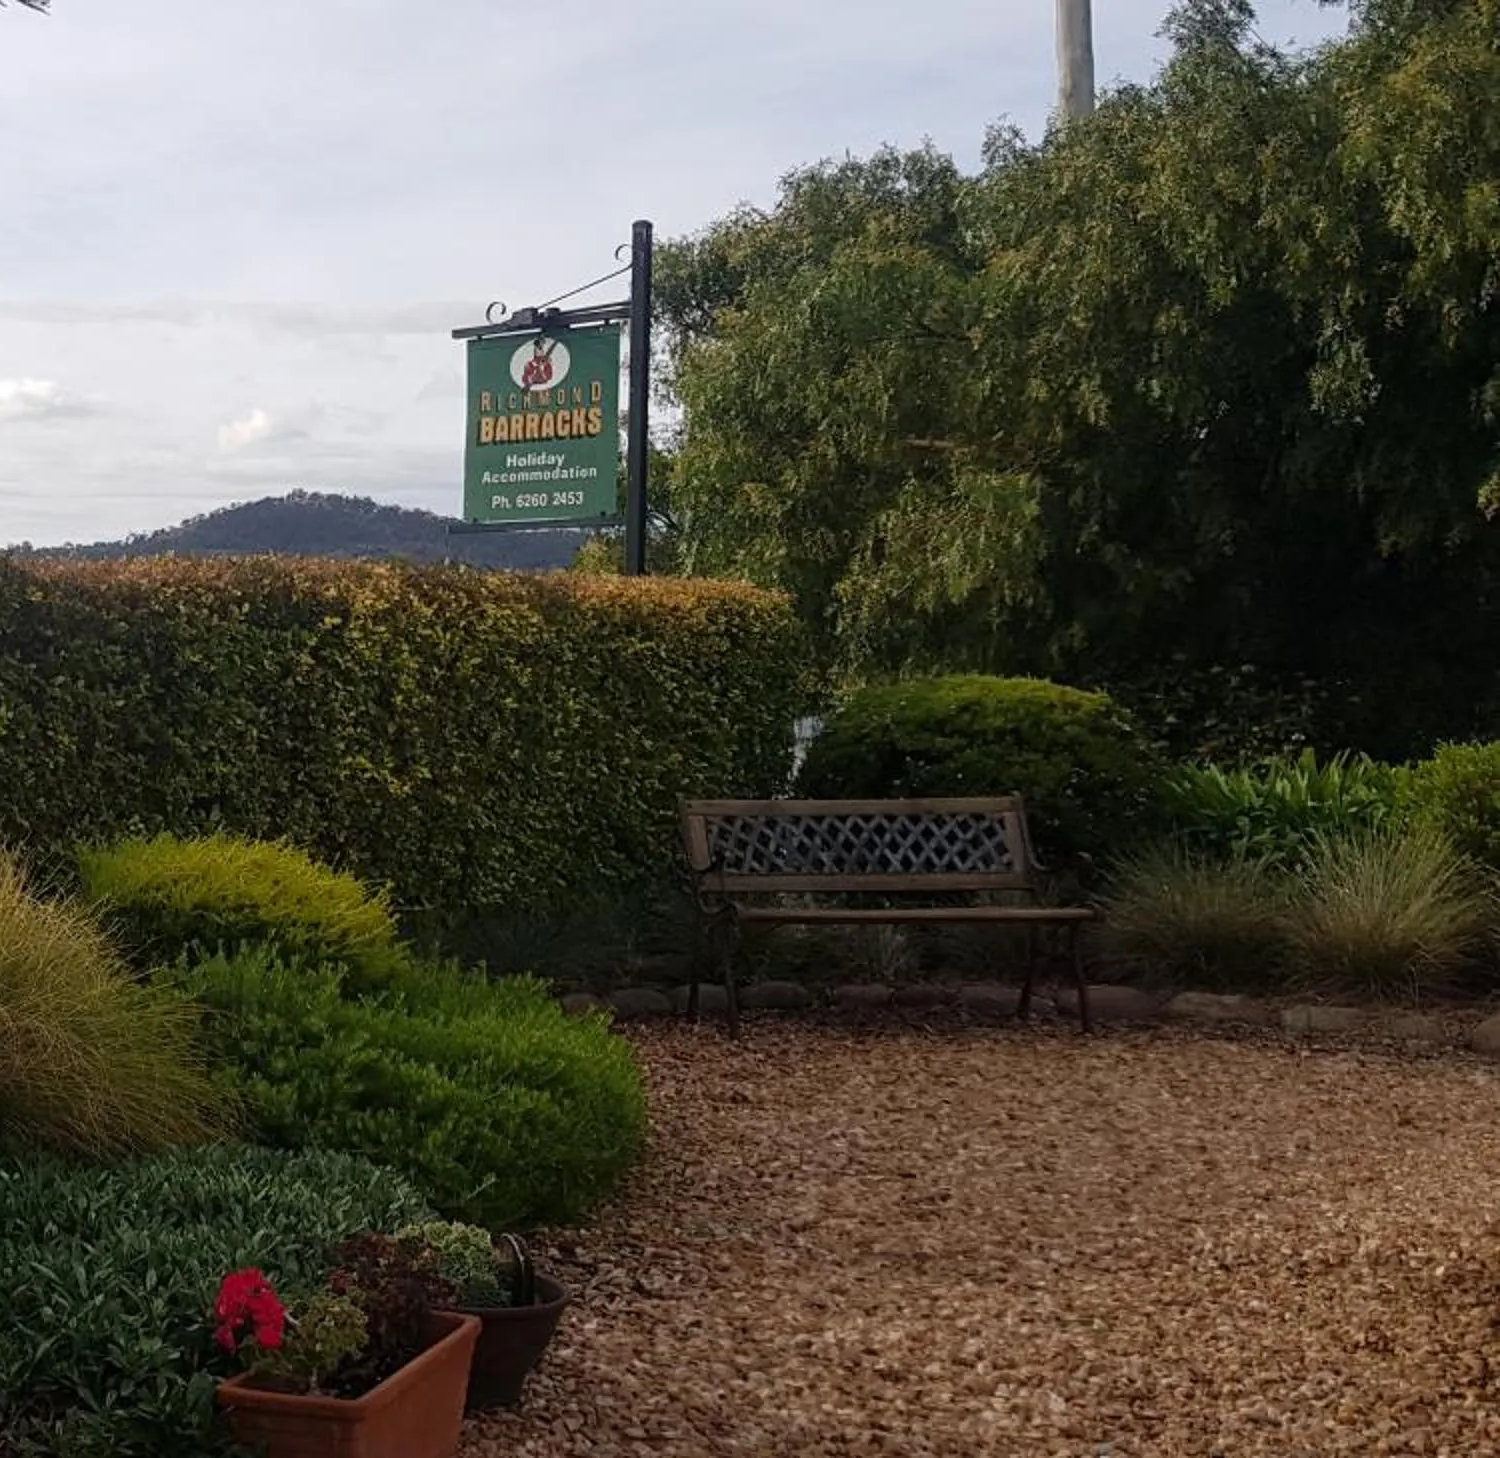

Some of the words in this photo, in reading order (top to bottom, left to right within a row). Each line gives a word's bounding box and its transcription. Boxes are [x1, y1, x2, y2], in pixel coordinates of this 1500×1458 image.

[480, 380, 602, 412] RICHMOND
[478, 407, 602, 445] BARRACKS
[506, 452, 565, 468] Holiday
[481, 466, 597, 484] Accommodation
[491, 495, 511, 509] Ph.
[516, 494, 547, 508] 6260
[552, 491, 584, 506] 2453
